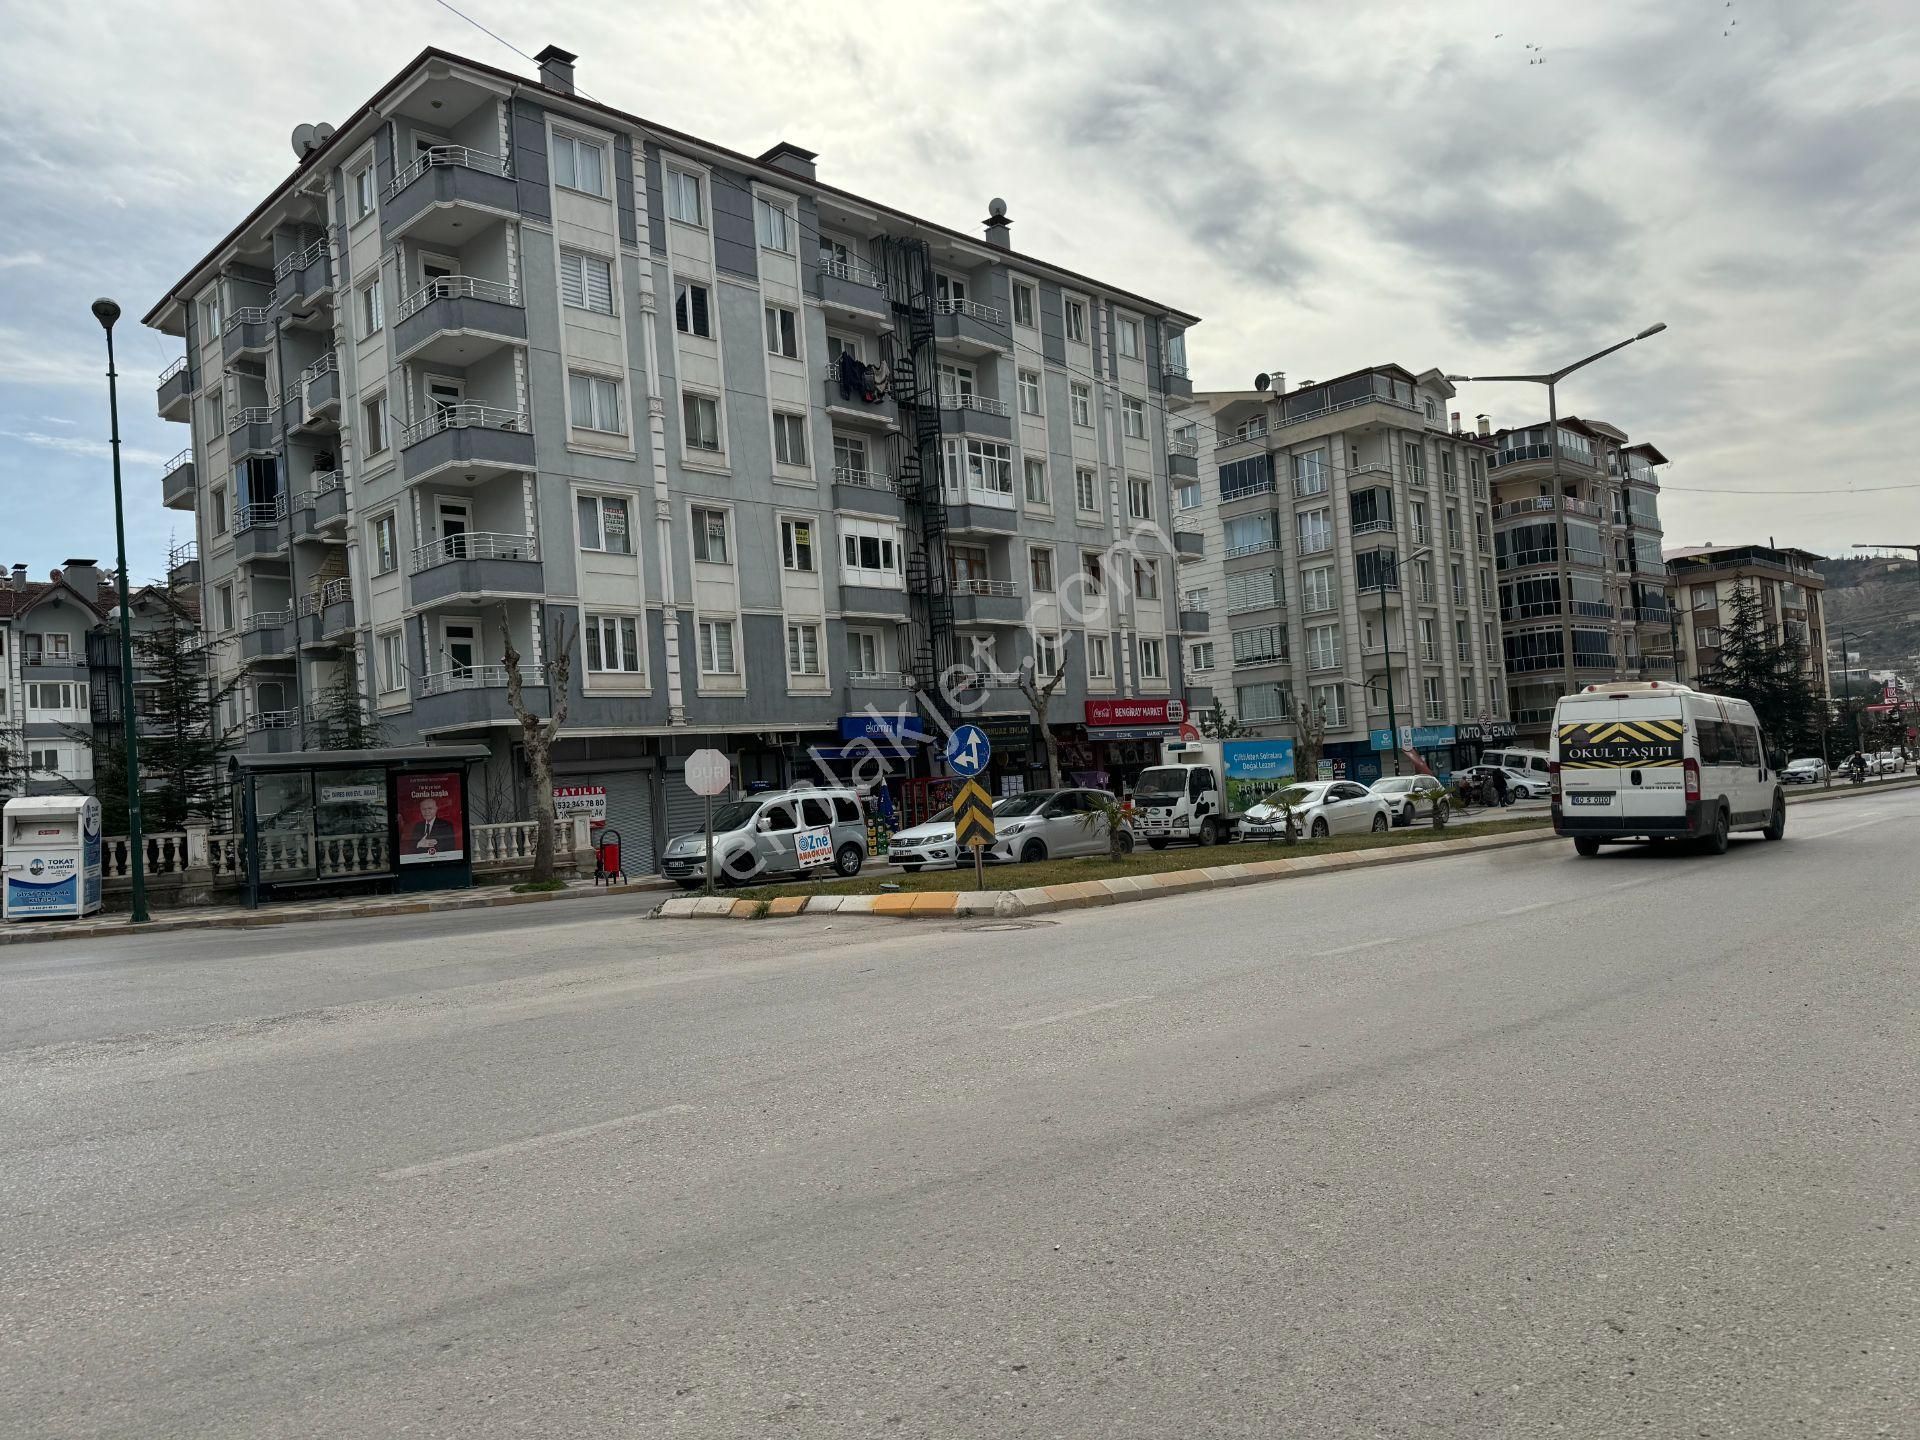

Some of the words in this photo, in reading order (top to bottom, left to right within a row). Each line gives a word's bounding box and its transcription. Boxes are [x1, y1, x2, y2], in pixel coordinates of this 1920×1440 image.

[1142, 706, 1164, 717] MARKET
[1568, 747, 1614, 759] OKUL
[1617, 746, 1672, 760] TAŞITI
[692, 766, 724, 778] DUR
[553, 786, 603, 797] SATILIK
